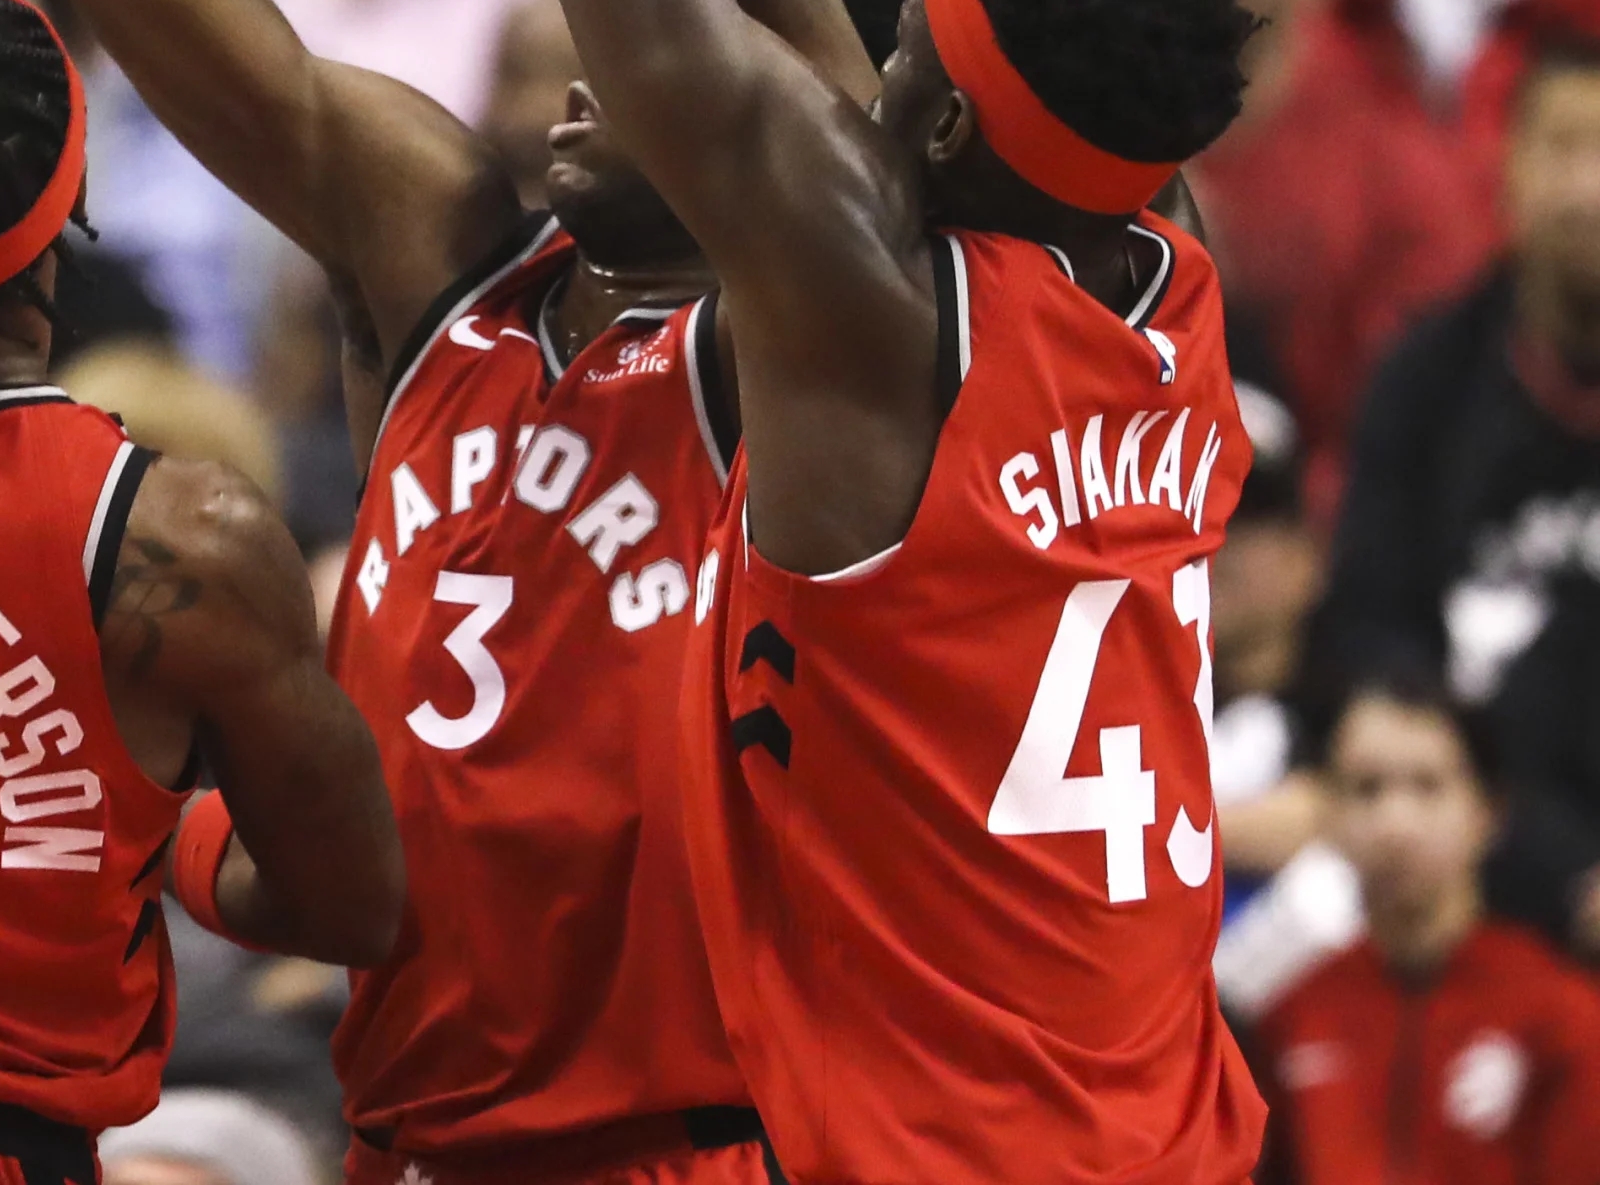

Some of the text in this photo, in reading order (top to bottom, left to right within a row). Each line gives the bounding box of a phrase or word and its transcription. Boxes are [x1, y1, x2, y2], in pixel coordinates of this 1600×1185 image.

[627, 353, 670, 375] Life
[356, 424, 689, 634] RAPORS
[999, 406, 1222, 551] SIAKAM
[404, 570, 514, 751] 3
